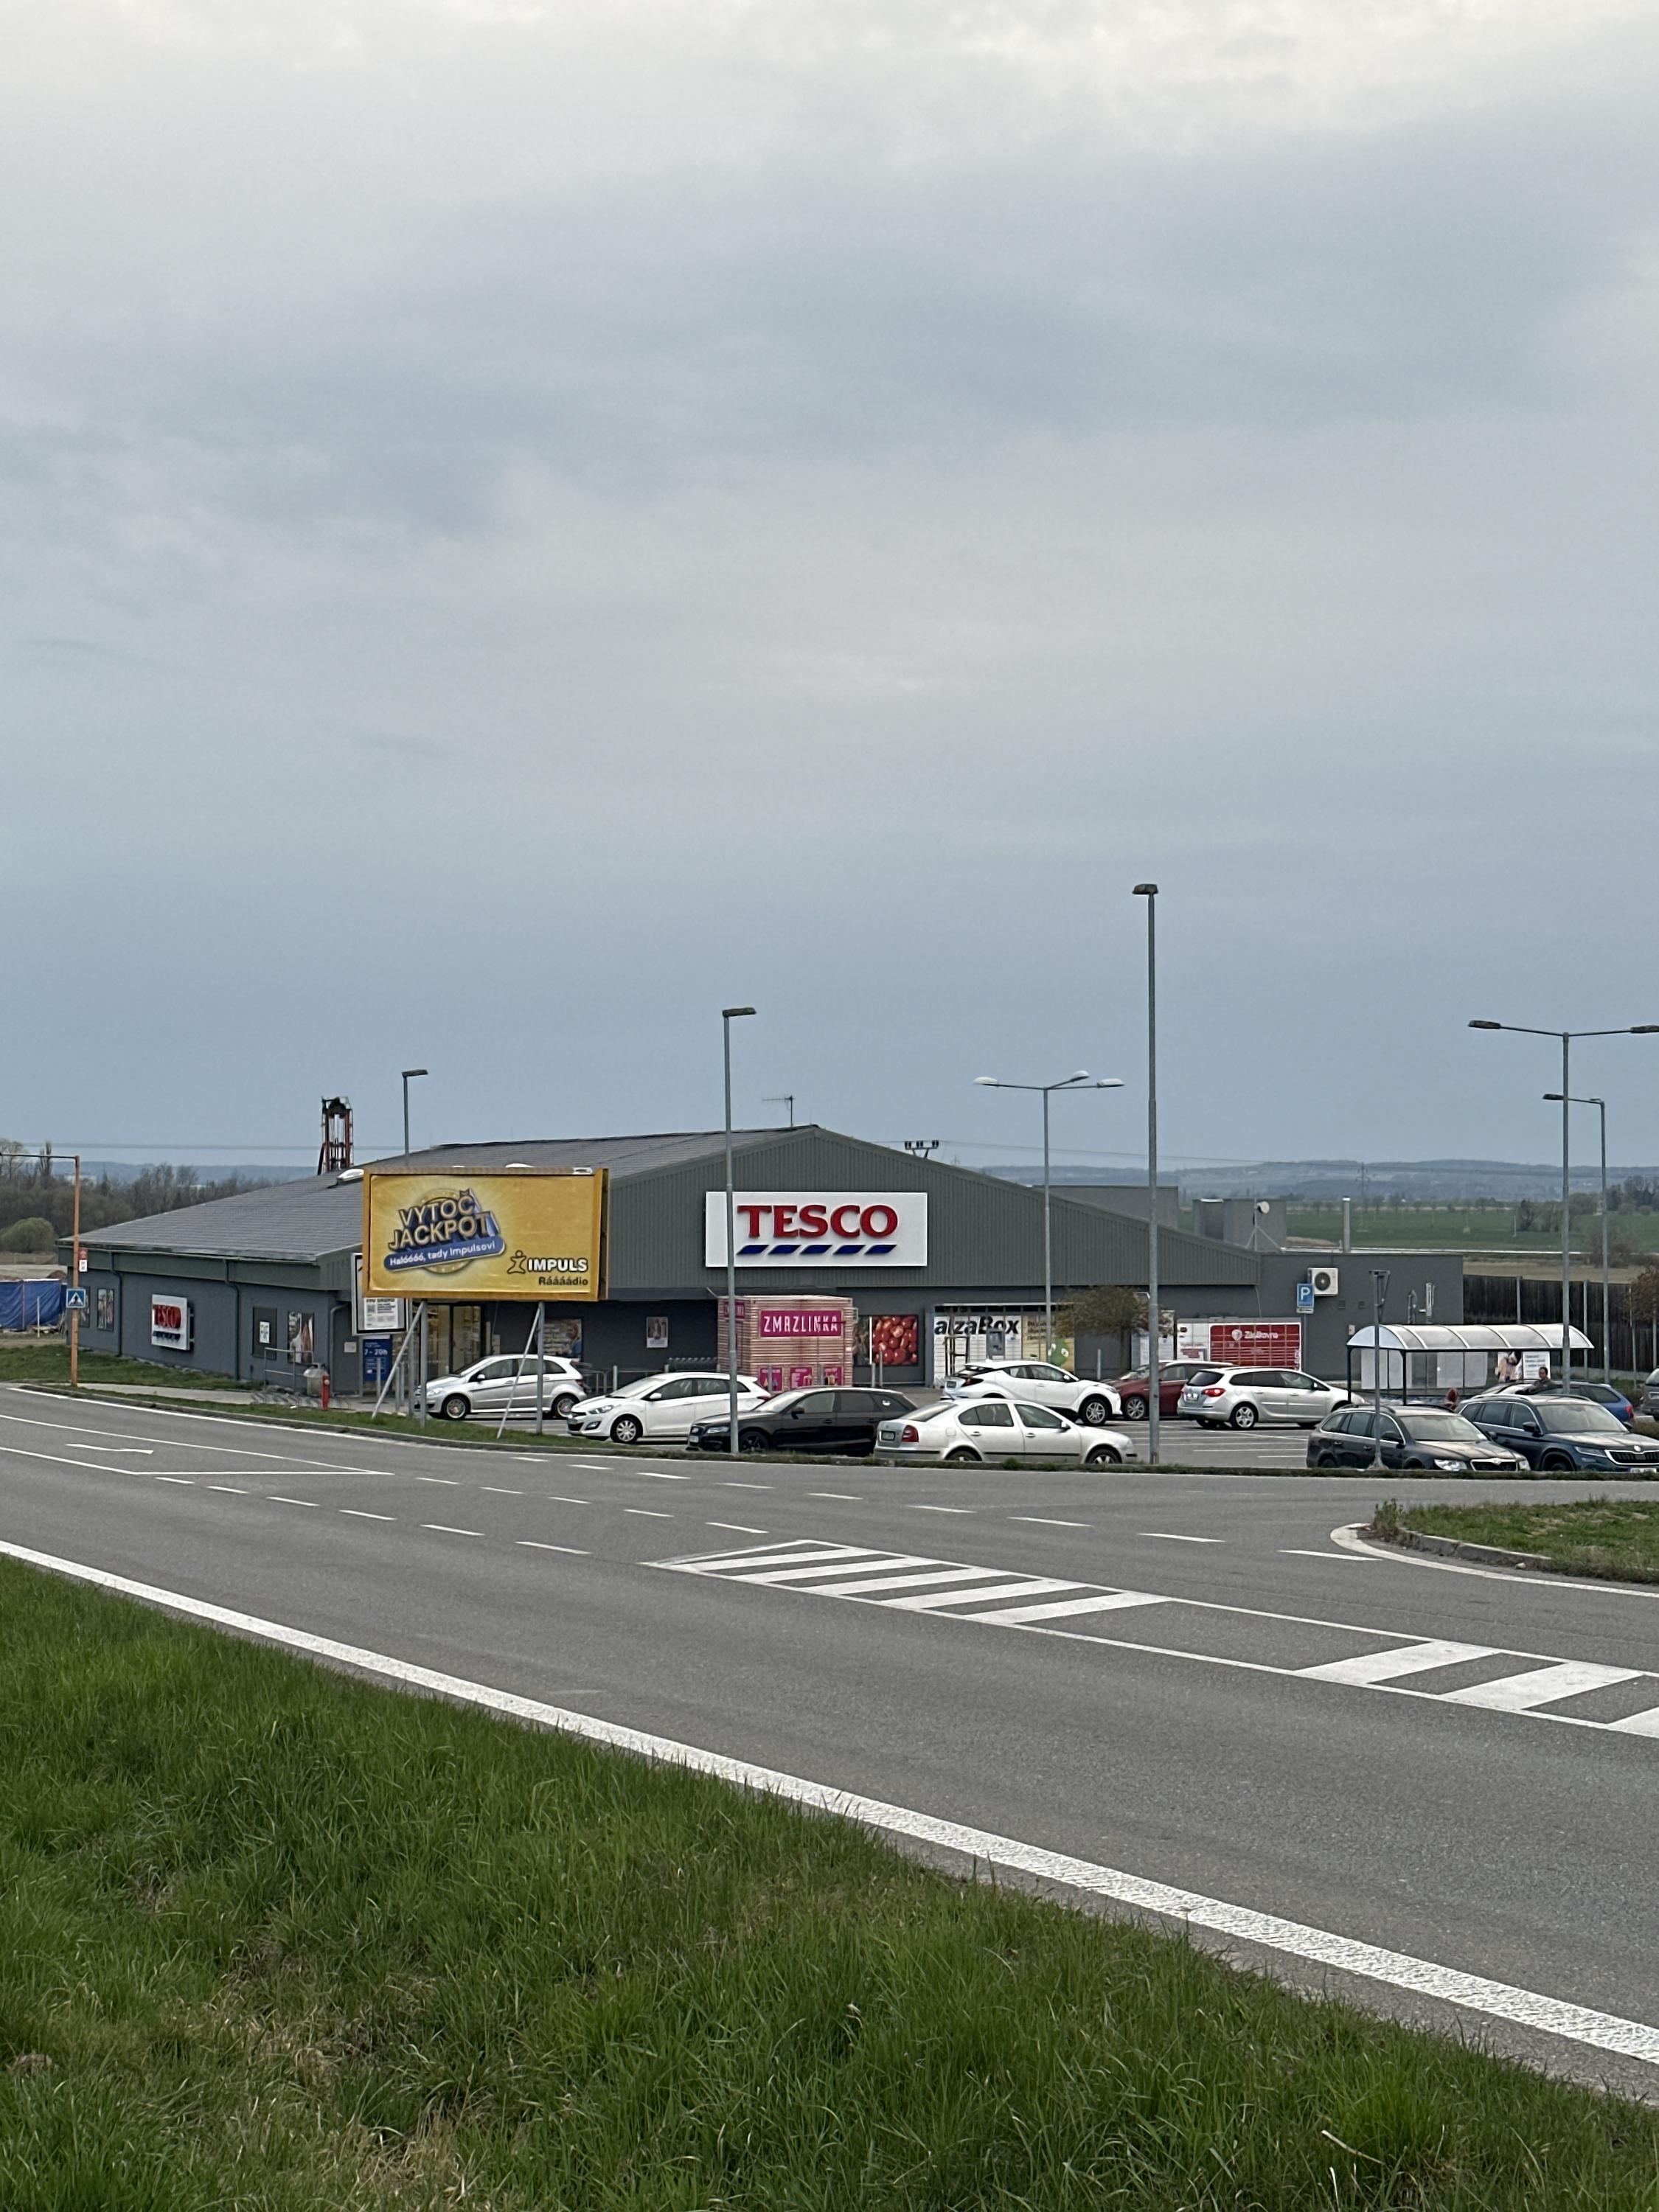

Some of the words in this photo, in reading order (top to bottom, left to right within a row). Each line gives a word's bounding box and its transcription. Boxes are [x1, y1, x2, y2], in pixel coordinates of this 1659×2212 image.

[399, 1189, 476, 1227] VYTOČ
[389, 1211, 491, 1251] JACKPOT
[737, 1204, 898, 1239] TESCO
[428, 1248, 448, 1259] tady
[527, 1258, 588, 1272] IMPULS
[1301, 1287, 1310, 1301] P
